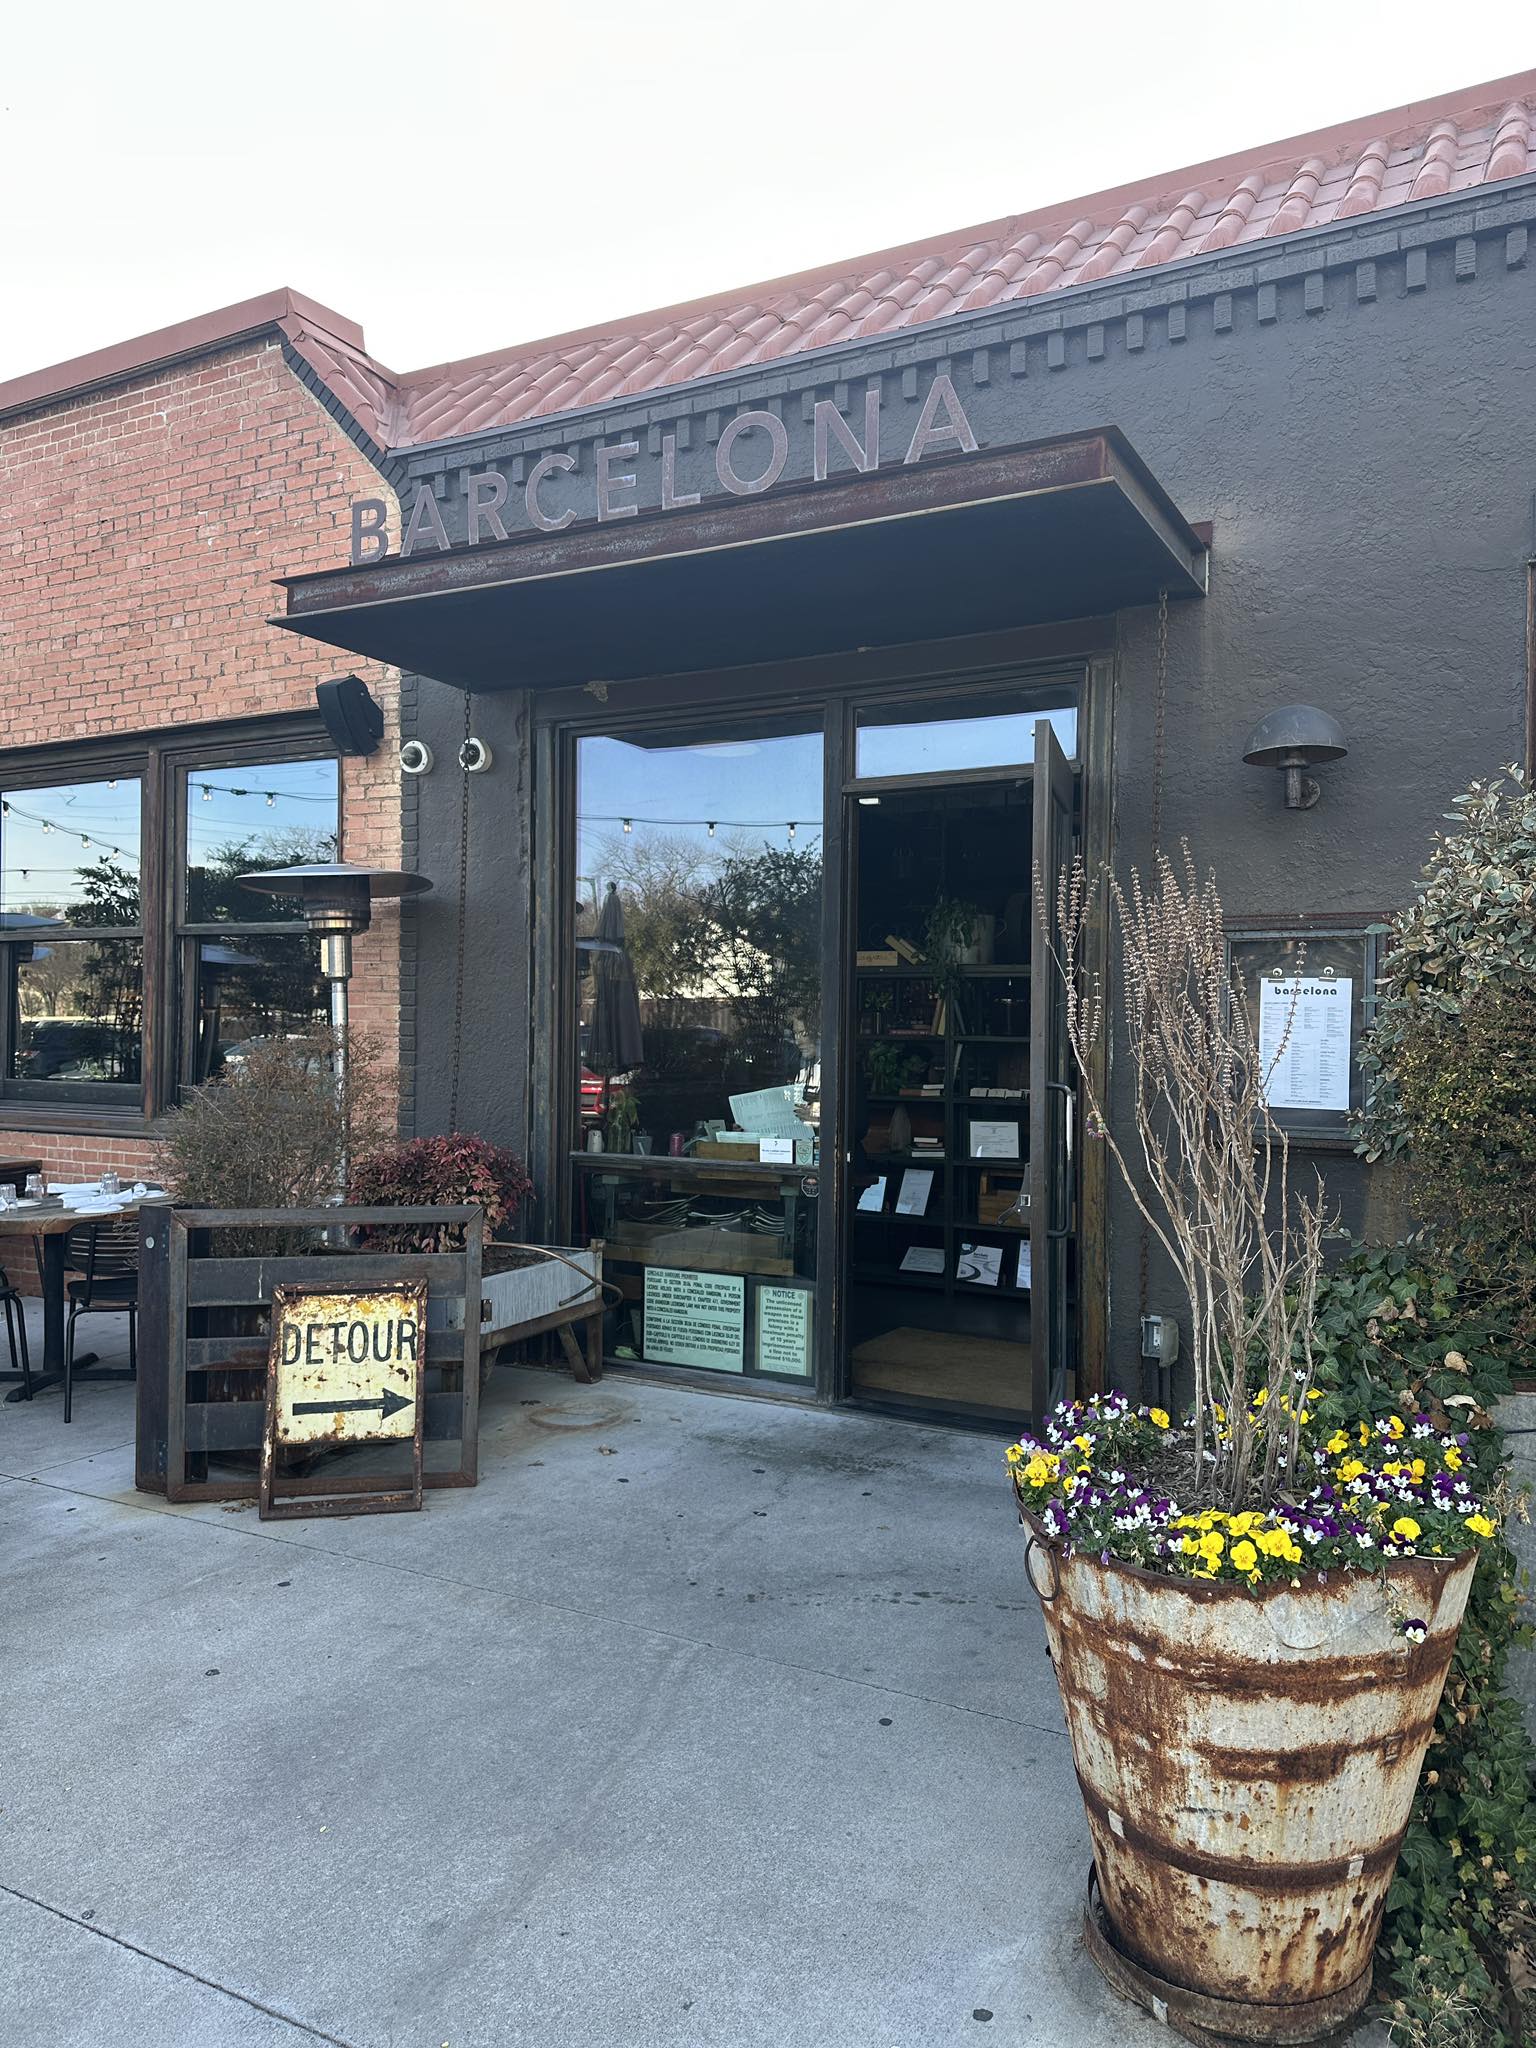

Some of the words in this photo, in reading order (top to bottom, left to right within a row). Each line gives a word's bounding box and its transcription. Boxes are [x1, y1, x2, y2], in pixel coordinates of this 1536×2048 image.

[352, 374, 979, 566] BARCELONA
[773, 1290, 795, 1299] NOTICE
[282, 1319, 417, 1366] DETOUR
